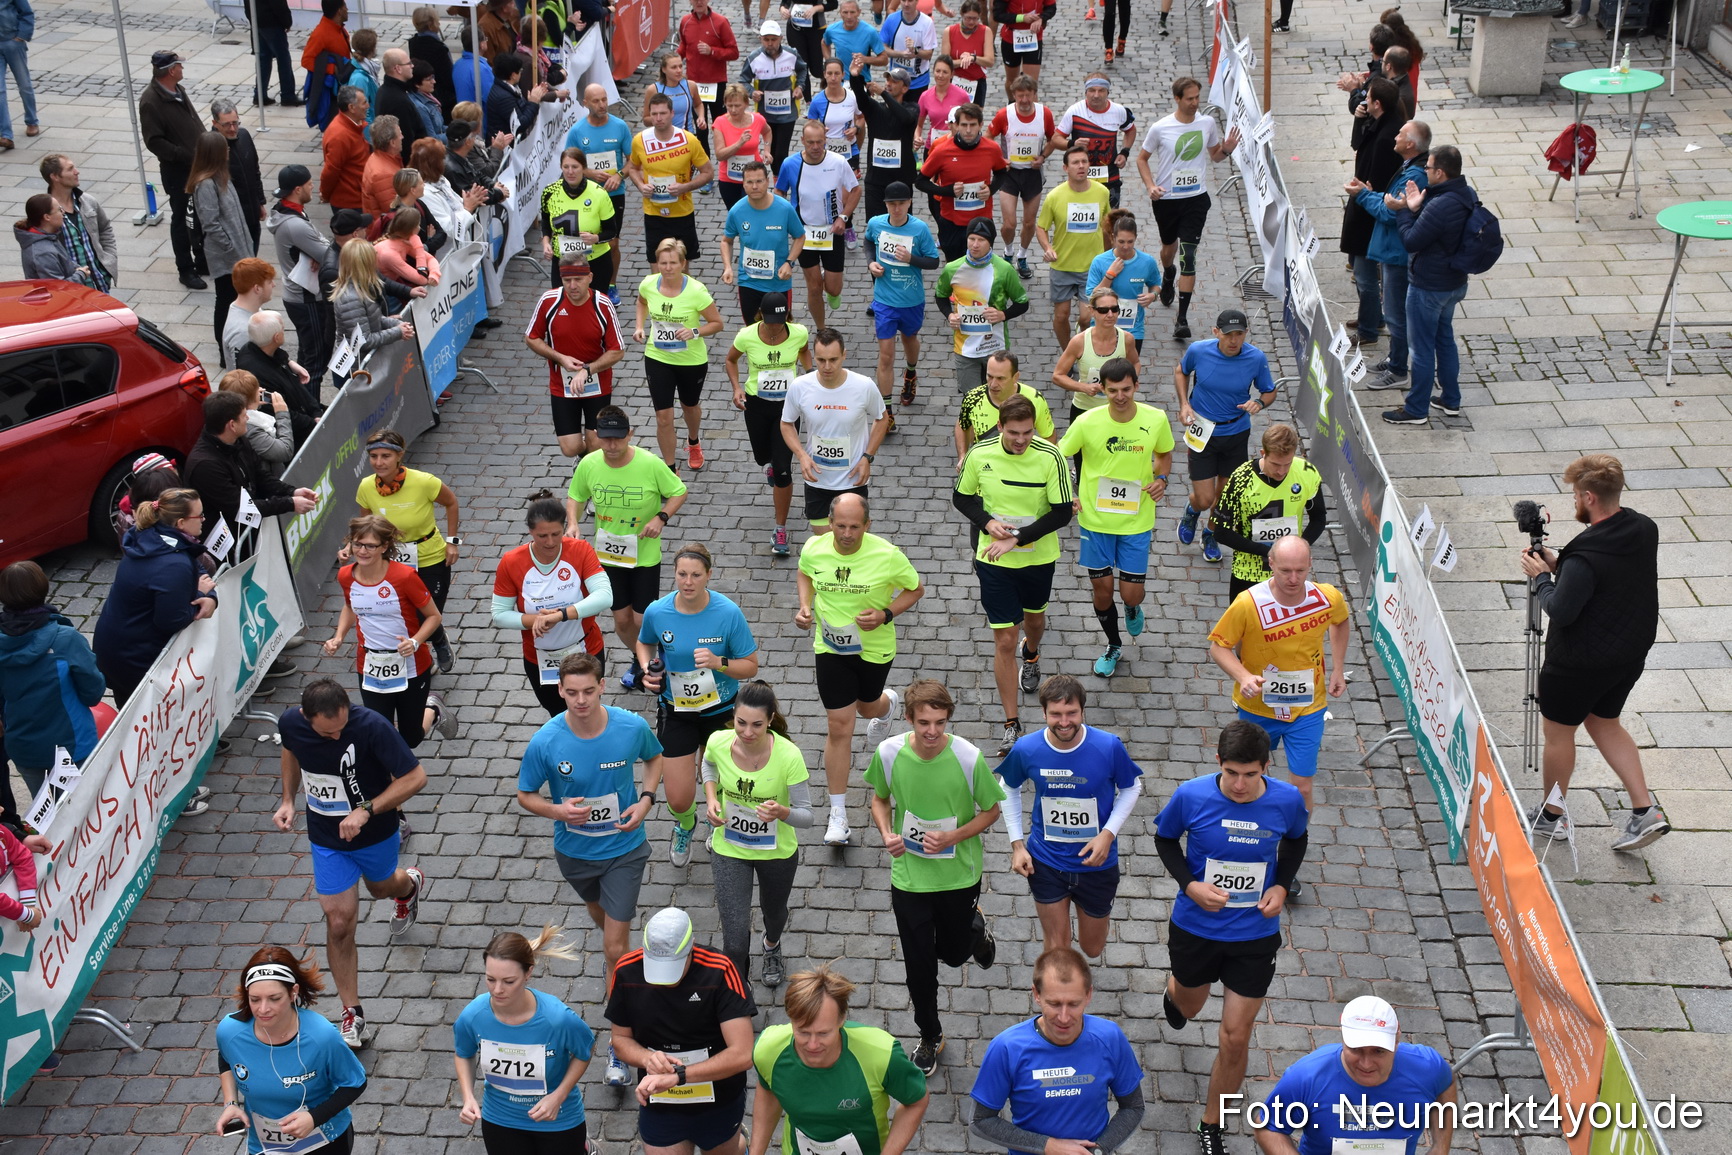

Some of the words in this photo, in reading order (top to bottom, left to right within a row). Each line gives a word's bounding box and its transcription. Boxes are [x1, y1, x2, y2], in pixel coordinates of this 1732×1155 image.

[768, 97, 787, 106] 2210
[647, 154, 666, 164] MAX
[668, 147, 690, 160] BÖGL
[876, 147, 896, 157] 2286
[1016, 146, 1032, 156] 168
[594, 160, 610, 170] 205
[1175, 175, 1198, 186] 2156
[1072, 212, 1095, 222] 2014
[811, 230, 827, 240] 140
[563, 242, 587, 253] 2680
[746, 257, 770, 268] 2583
[335, 352, 349, 371] swn
[1351, 360, 1364, 378] swn
[762, 379, 788, 391] 2271
[816, 445, 844, 457] 2395
[1110, 487, 1127, 499] 94
[1259, 527, 1292, 542] 2692
[212, 534, 226, 553] swn
[604, 542, 627, 555] 237
[1439, 542, 1454, 565] swn
[557, 583, 576, 591] KOPPE
[1264, 626, 1297, 643] MAX
[1300, 612, 1334, 633] BÖGL
[698, 637, 724, 645] BOCK
[824, 629, 853, 645] 2197
[368, 664, 400, 678] 2769
[683, 684, 701, 697] 52
[1269, 681, 1307, 695] 2615
[600, 759, 627, 771] BOCK
[1046, 769, 1068, 777] HEUTE
[308, 784, 337, 799] 2347
[33, 798, 52, 824] swn
[1050, 810, 1090, 827] 2150
[731, 815, 768, 835] 2094
[1230, 821, 1253, 829] HEUTE
[1228, 836, 1260, 845] BEWEGEN
[1212, 873, 1256, 891] 2502
[90, 888, 138, 970] Service-Line:
[1523, 923, 1532, 938] die
[1527, 907, 1549, 954] Neumarkts
[490, 1057, 535, 1078] 2712
[1042, 1067, 1070, 1078] HEUTE
[1051, 1075, 1090, 1086] MORGEN
[667, 1087, 694, 1098] Michael
[1044, 1087, 1082, 1098] BEWEGEN
[838, 1097, 861, 1109] AOK
